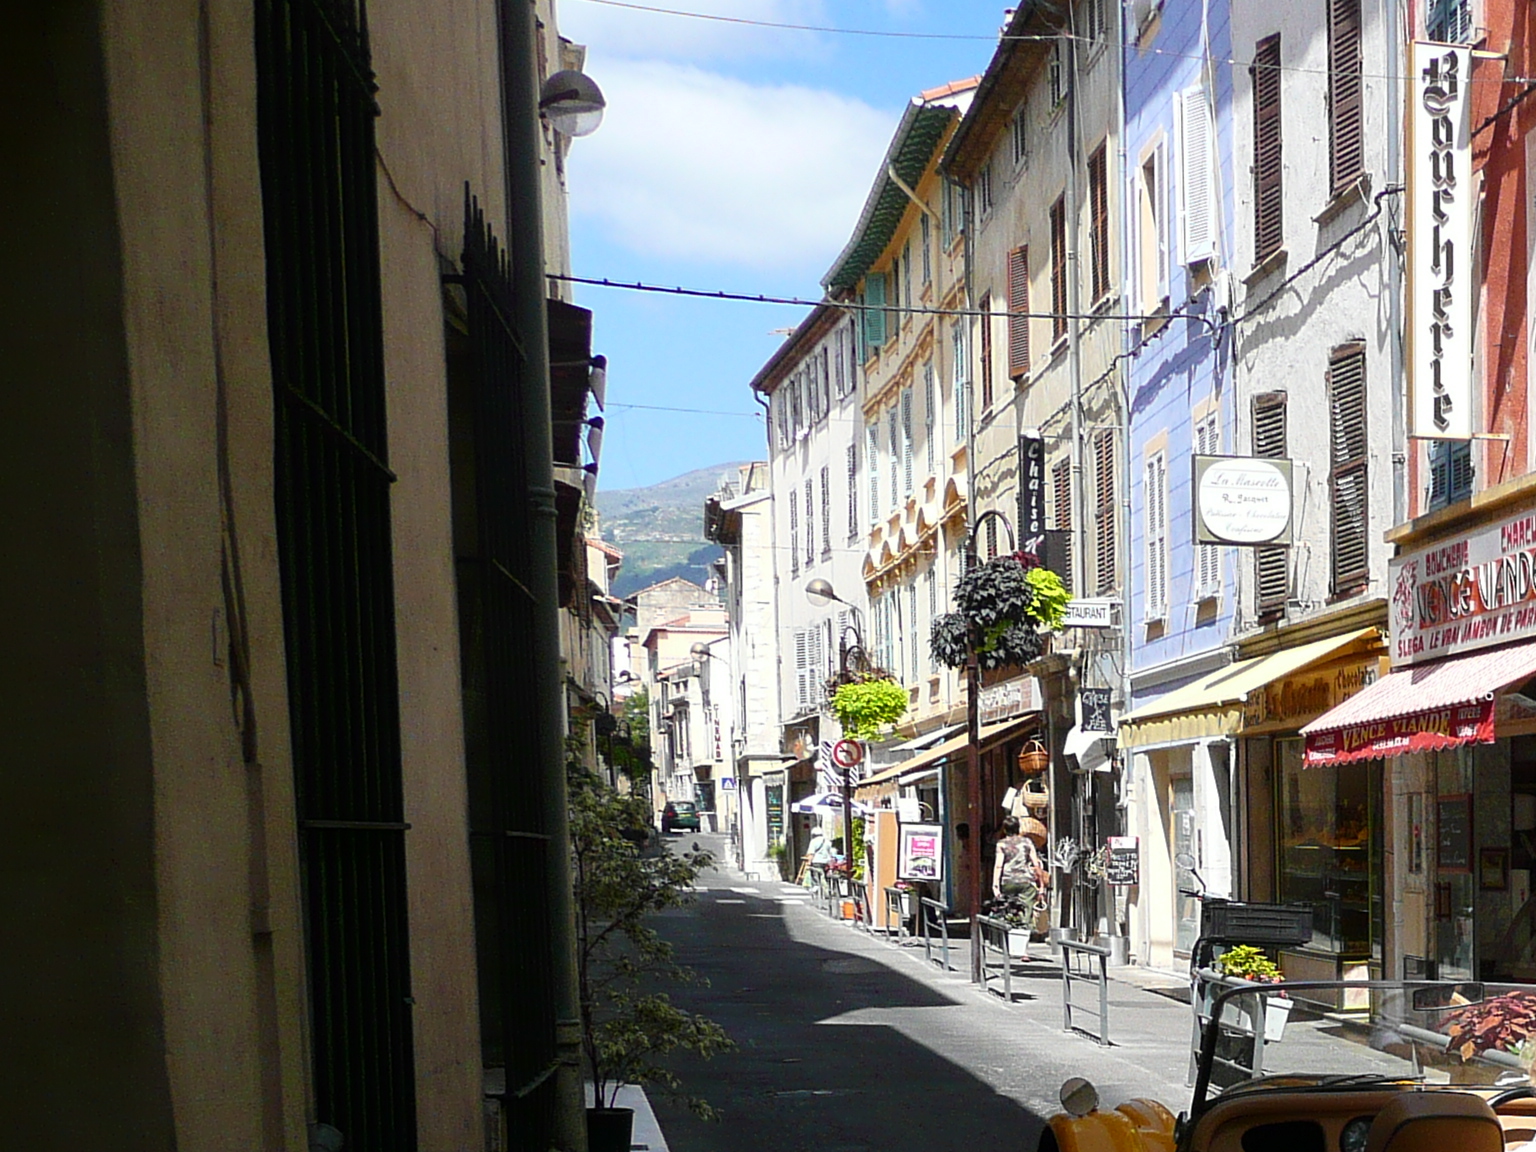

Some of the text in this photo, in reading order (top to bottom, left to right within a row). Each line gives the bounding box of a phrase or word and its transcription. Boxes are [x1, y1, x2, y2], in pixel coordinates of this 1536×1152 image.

[1421, 49, 1459, 433] Boucherie
[1028, 442, 1039, 532] Chaise
[1425, 539, 1469, 576] BOUCHERIE
[1066, 607, 1106, 619] STAURANT
[1416, 568, 1473, 623] VENCE
[1429, 631, 1440, 650] LE
[1441, 625, 1460, 647] VRAI
[1461, 615, 1500, 643] JAMBON
[1500, 611, 1514, 635] DE
[1342, 723, 1386, 751] VENCE
[1392, 711, 1451, 736] VIANDE
